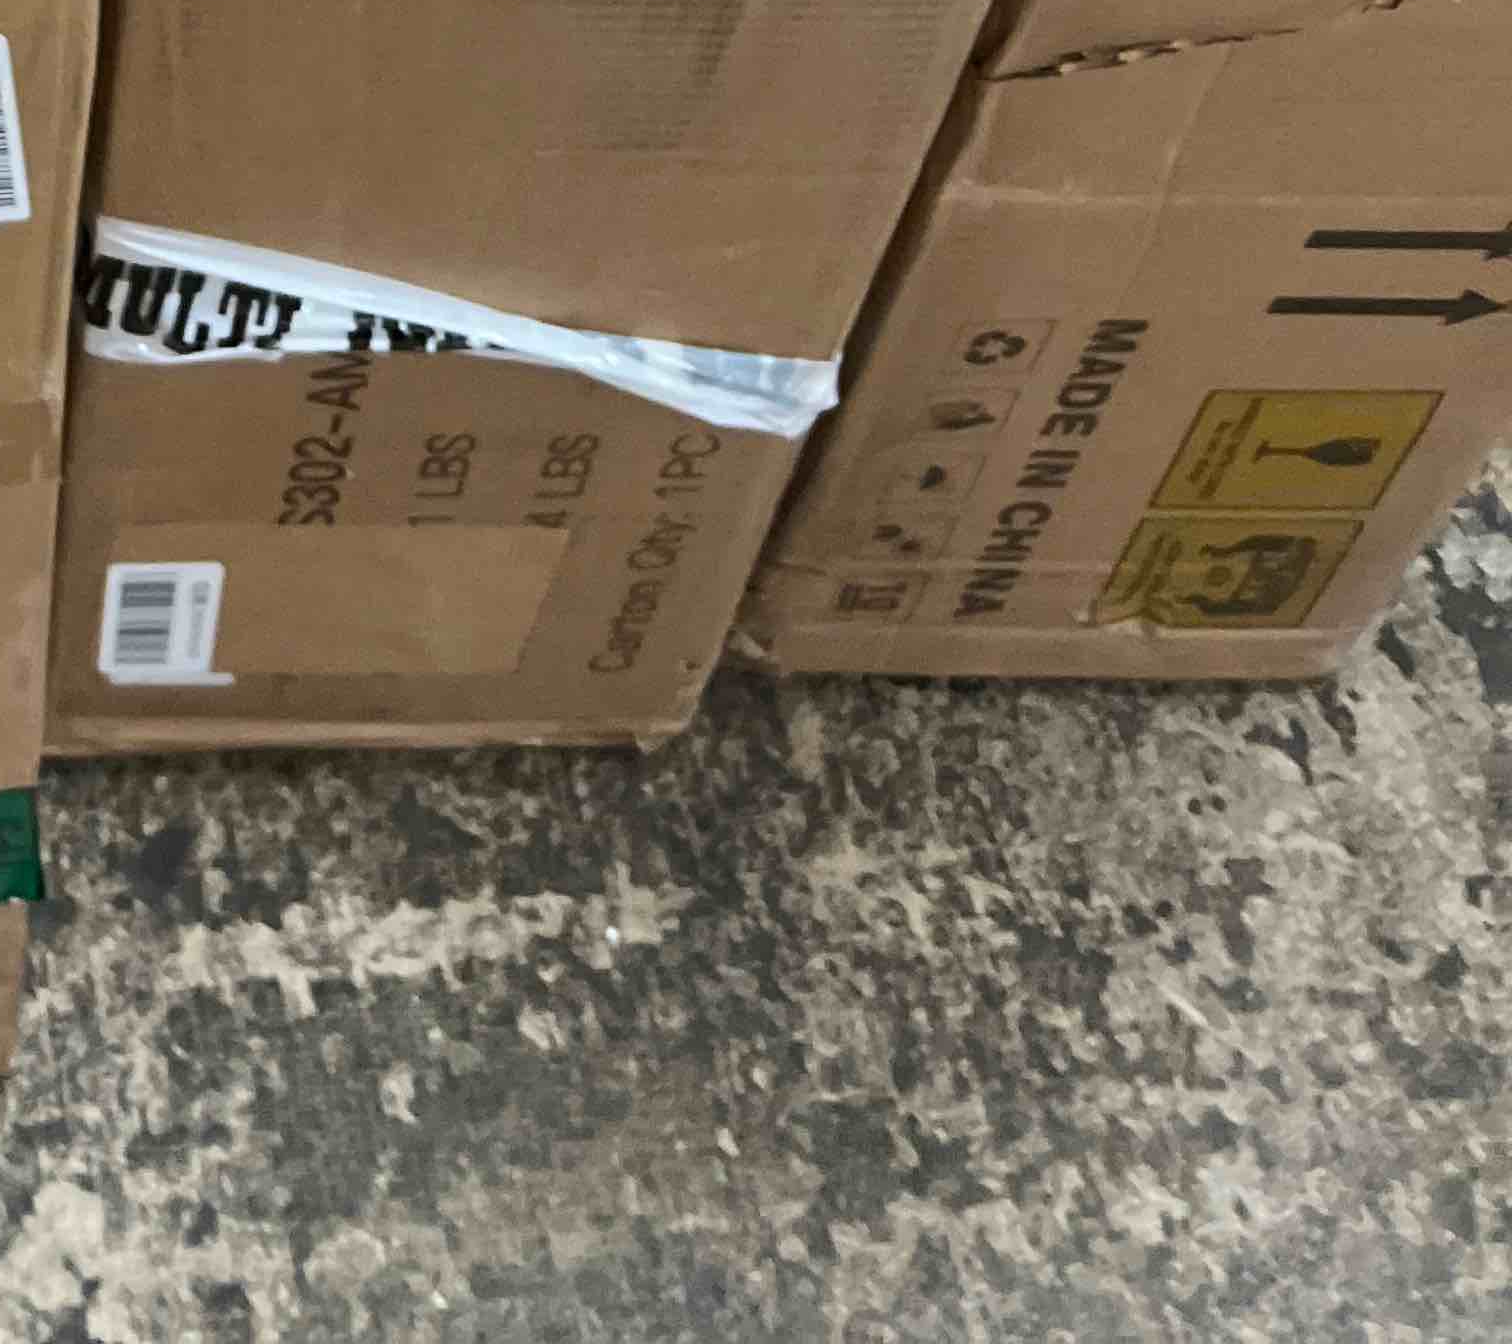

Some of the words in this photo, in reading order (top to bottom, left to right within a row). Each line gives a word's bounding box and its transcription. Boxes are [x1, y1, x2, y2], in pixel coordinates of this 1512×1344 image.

[1040, 319, 1149, 436] MADE
[414, 433, 477, 499] LBS
[536, 433, 600, 499] LBS
[1016, 449, 1080, 489] IN
[952, 501, 1053, 618] CHINA
